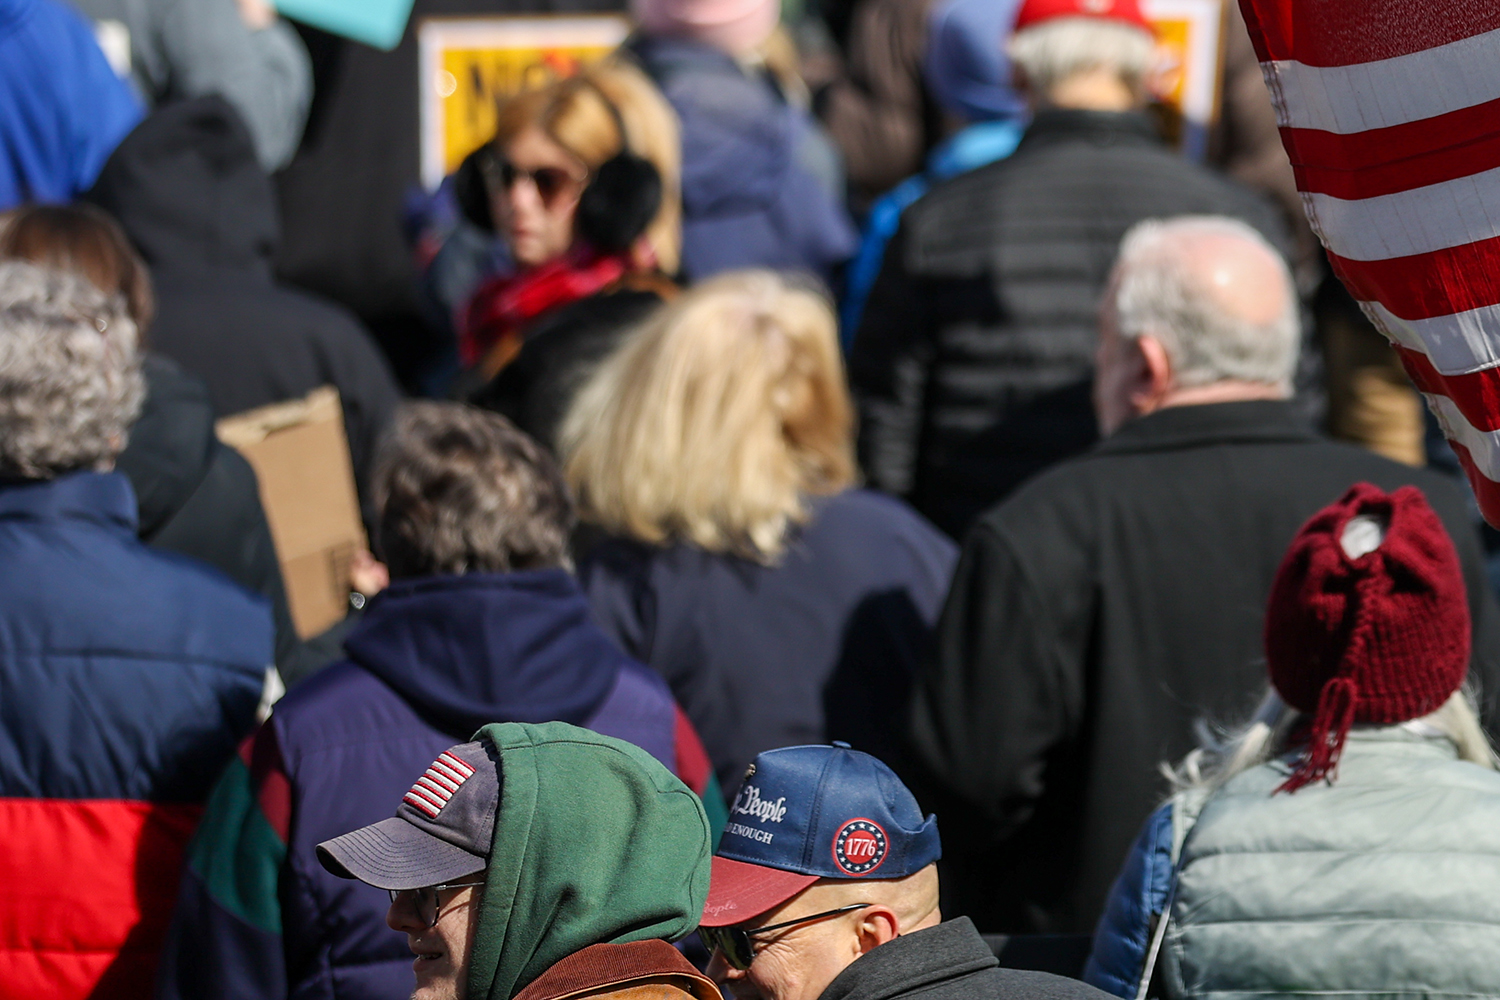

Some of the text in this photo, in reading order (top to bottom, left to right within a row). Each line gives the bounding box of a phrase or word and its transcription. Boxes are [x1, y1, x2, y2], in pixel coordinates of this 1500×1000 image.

[738, 785, 787, 823] People
[731, 823, 774, 844] ENOUGH
[846, 838, 877, 857] 1776
